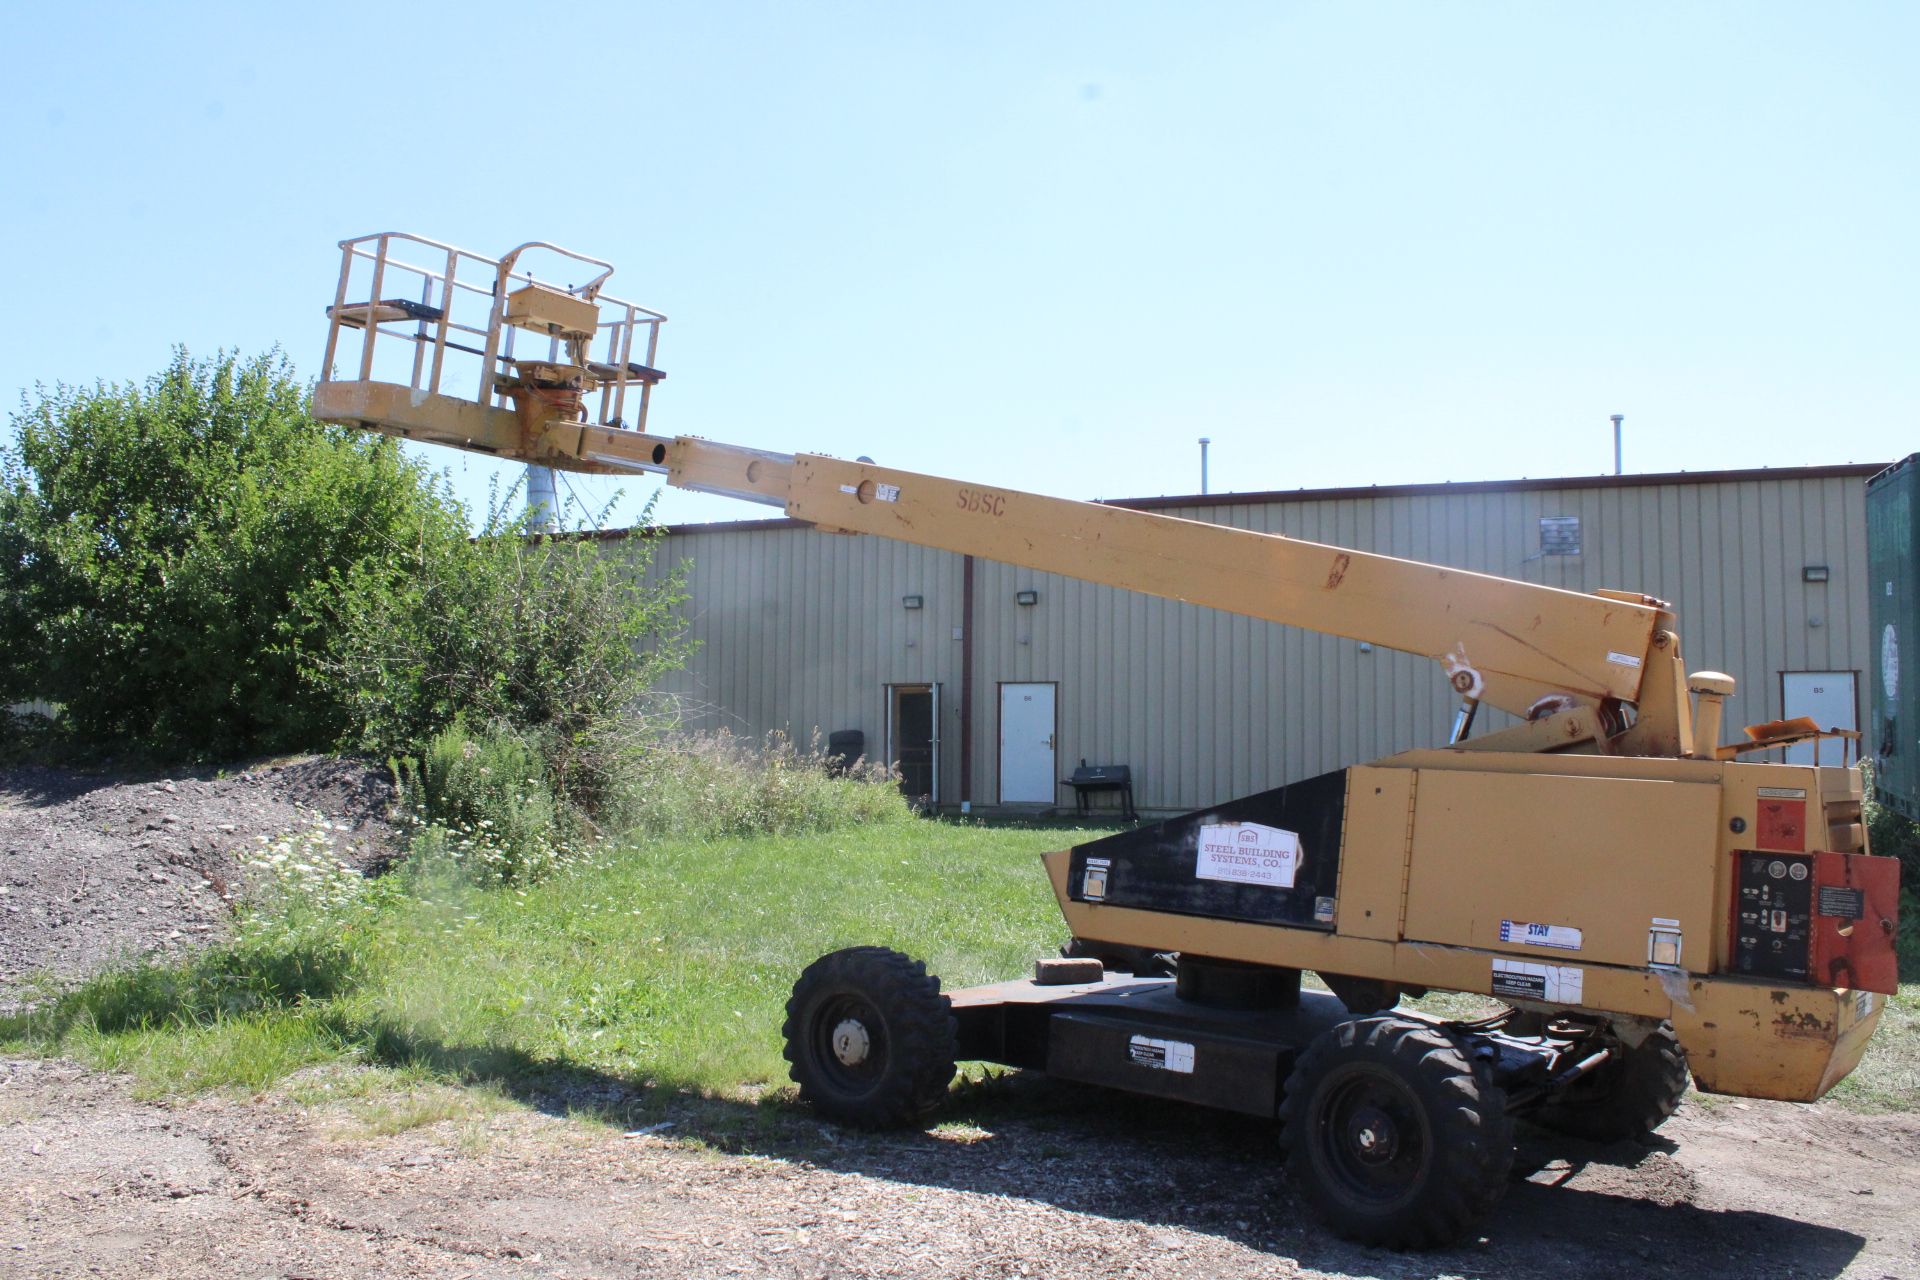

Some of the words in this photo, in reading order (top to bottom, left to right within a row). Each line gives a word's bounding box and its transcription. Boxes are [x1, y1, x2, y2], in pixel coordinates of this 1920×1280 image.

[957, 488, 1006, 517] SBSC
[1204, 844, 1236, 855] STEEL
[1238, 847, 1290, 859] BUILDING
[1211, 854, 1260, 867] SYSTEMS,
[1263, 859, 1281, 868] CO.
[1528, 924, 1550, 937] STAY
